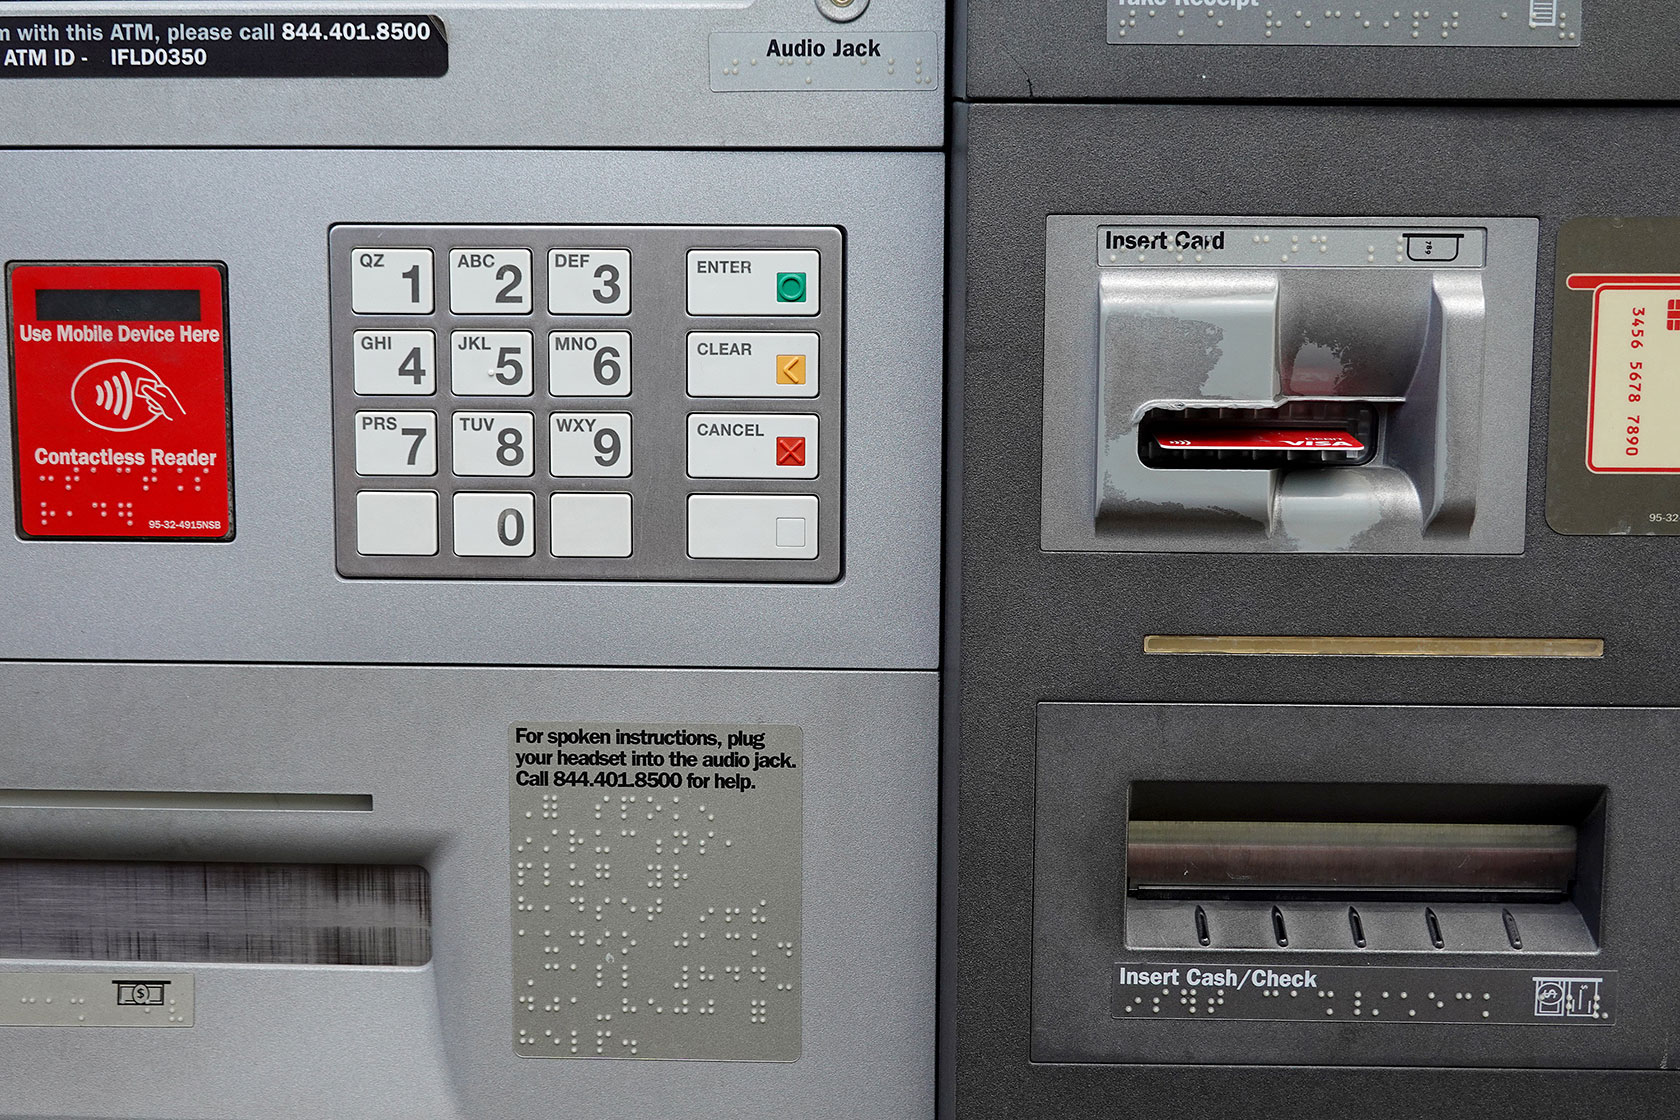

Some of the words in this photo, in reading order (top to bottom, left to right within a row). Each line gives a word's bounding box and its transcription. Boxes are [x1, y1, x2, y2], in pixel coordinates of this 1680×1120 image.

[17, 24, 60, 41] with
[66, 24, 103, 41] this
[110, 24, 160, 43] ATM,
[167, 24, 233, 44] please
[238, 24, 275, 41] call
[281, 22, 430, 41] 844.401.8500
[4, 48, 47, 66] ATM
[54, 48, 75, 66] ID
[110, 48, 207, 66] IFLD0350
[766, 39, 825, 57] Audio
[832, 39, 881, 57] Jack
[1105, 231, 1168, 250] Insert
[1175, 231, 1225, 250] Card
[359, 253, 385, 268] QZ
[457, 254, 496, 268] ABC
[555, 254, 590, 268] DEF
[697, 261, 752, 274] ENTER
[402, 265, 420, 303] 1
[495, 264, 523, 303] 2
[592, 264, 621, 304] 3
[20, 325, 52, 342] Use
[57, 325, 113, 342] Mobile
[118, 325, 175, 342] Device
[180, 325, 220, 342] Here
[1630, 307, 1646, 349] 3456
[361, 336, 392, 350] GHI
[458, 337, 491, 350] JKL
[555, 338, 598, 351] MNO
[697, 343, 752, 356] CLEAR
[398, 347, 426, 385] 4
[495, 347, 523, 386] 5
[593, 346, 621, 386] 6
[1628, 361, 1643, 403] 5678
[362, 417, 397, 430] PRS
[460, 418, 495, 431] TUV
[556, 419, 597, 432] WXY
[697, 423, 765, 437] CANCEL
[1625, 415, 1640, 456] 7890
[401, 428, 427, 465] 7
[496, 428, 524, 466] 8
[593, 428, 621, 467] 9
[34, 448, 145, 466] Contactless
[151, 449, 216, 466] Reader
[149, 520, 221, 529] 95-32-4915NSB
[497, 508, 525, 546] 0
[515, 727, 544, 744] For
[547, 728, 611, 748] spoken
[615, 729, 722, 748] instructions,
[727, 731, 765, 749] plug
[515, 751, 553, 766] your
[557, 750, 626, 766] headset
[631, 751, 664, 767] into
[669, 751, 698, 767] the
[702, 751, 750, 768] audio
[753, 752, 796, 771] jack.
[515, 770, 549, 787] Call
[553, 771, 682, 788] 844.401.8500
[687, 772, 710, 789] for
[714, 773, 756, 792] help.
[1120, 968, 1179, 985] Insert
[1186, 968, 1317, 990] Cash/Check
